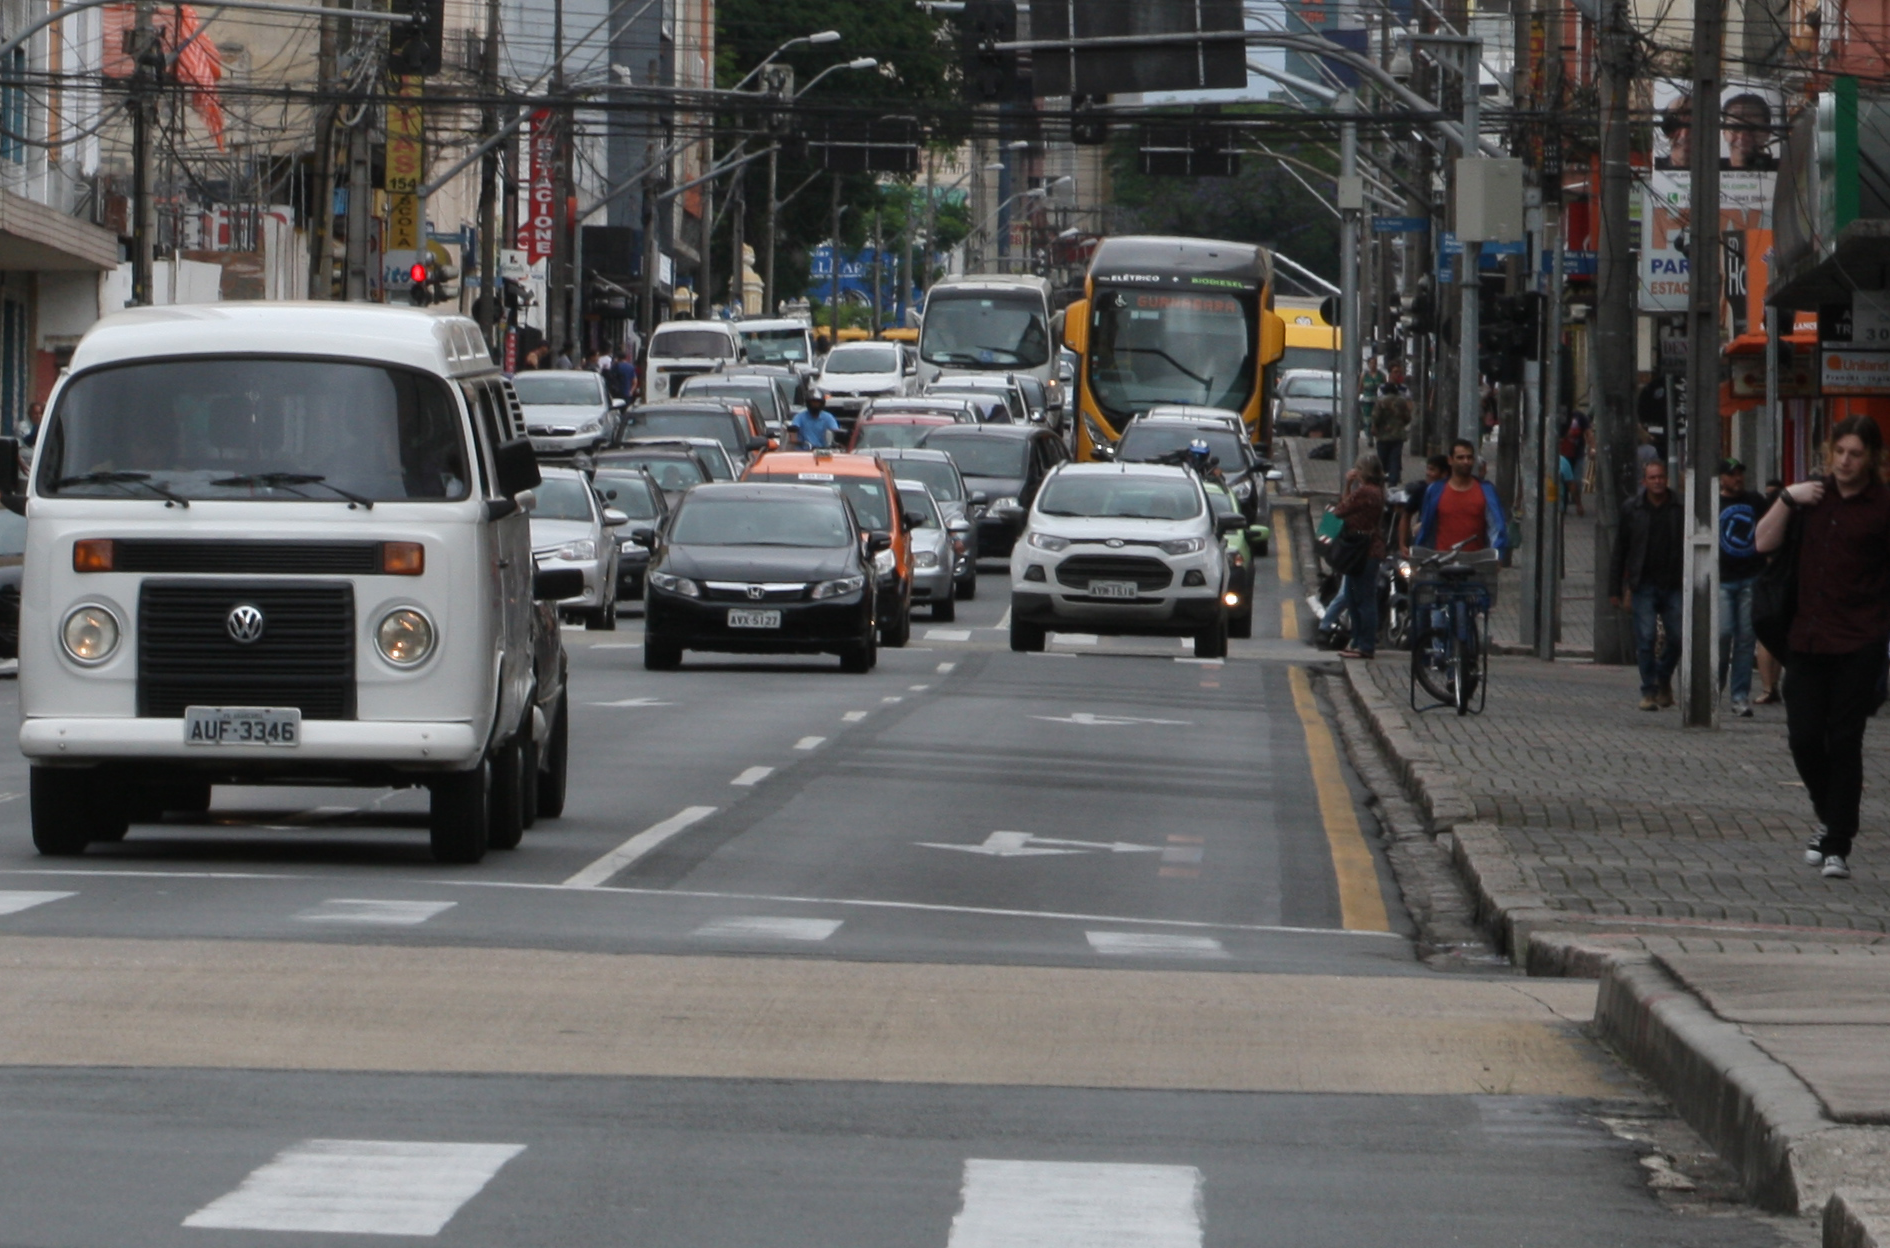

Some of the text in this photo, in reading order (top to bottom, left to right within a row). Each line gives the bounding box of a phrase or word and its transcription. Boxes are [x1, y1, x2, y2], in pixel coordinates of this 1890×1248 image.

[391, 177, 417, 190] 154
[1111, 274, 1160, 283] ELÉTRICO
[1190, 276, 1245, 290] BIODIESEL
